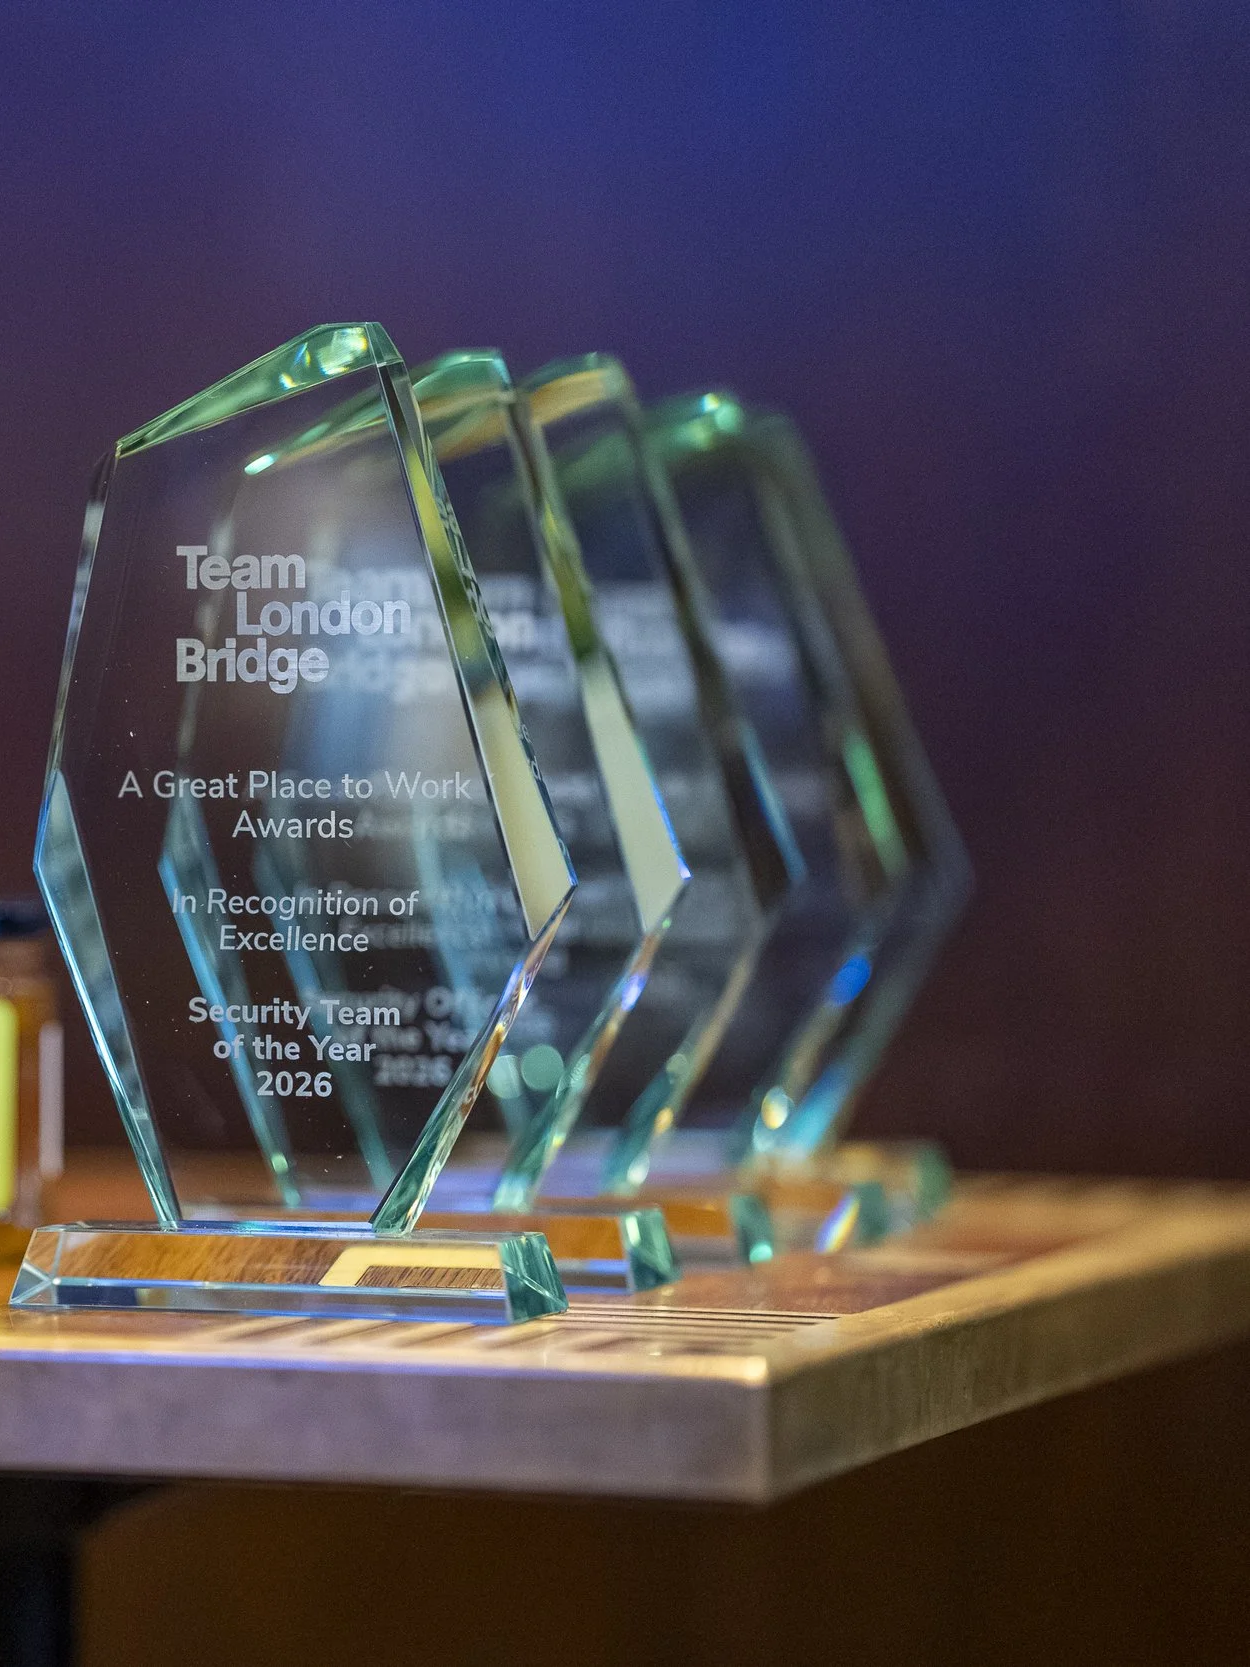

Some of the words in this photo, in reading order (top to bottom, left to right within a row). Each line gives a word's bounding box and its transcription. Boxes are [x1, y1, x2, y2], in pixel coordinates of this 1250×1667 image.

[176, 545, 306, 590] Team
[236, 591, 411, 636] London
[176, 638, 330, 694] Bridge
[118, 771, 143, 798] A
[153, 770, 238, 799] Great
[249, 770, 331, 799] Place
[341, 772, 373, 799] to
[385, 770, 472, 799] Work
[232, 810, 354, 839] Awards
[172, 889, 196, 914] In
[207, 888, 379, 920] Recognition
[389, 890, 420, 916] of
[219, 925, 369, 952] Excellence
[188, 997, 311, 1031] Security
[319, 999, 400, 1026] Team
[213, 1035, 244, 1059] of
[252, 1035, 301, 1060] the
[308, 1038, 376, 1062] Year
[256, 1070, 332, 1097] 2026
